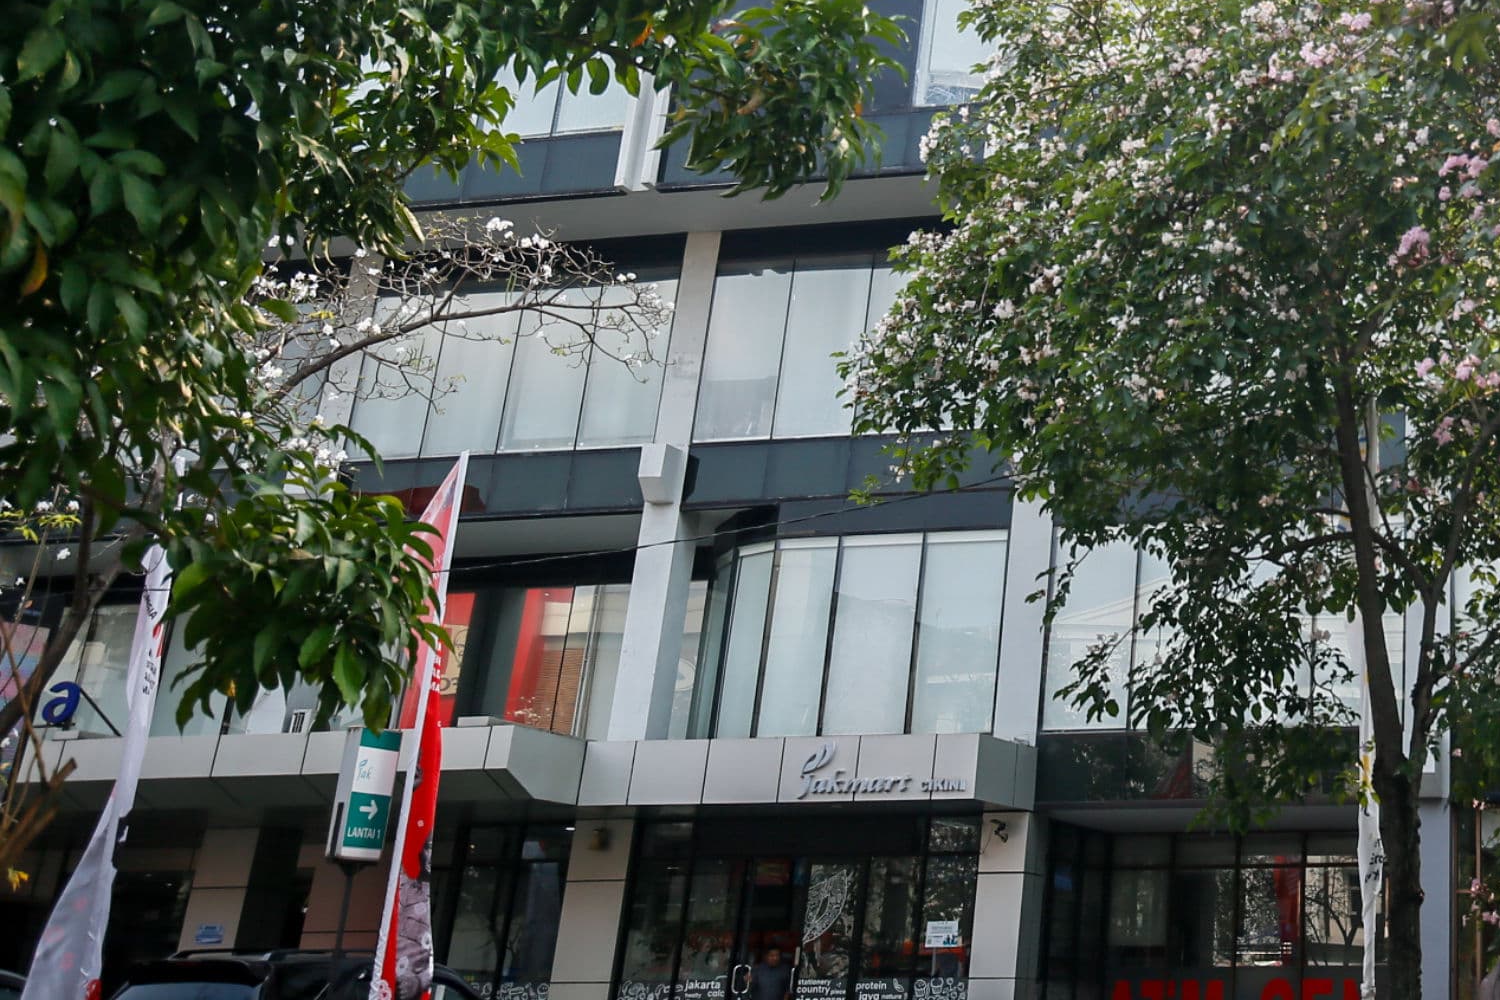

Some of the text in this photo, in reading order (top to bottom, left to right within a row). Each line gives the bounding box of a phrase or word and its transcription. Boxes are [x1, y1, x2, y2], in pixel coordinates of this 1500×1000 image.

[920, 778, 968, 792] CIKINI
[347, 827, 376, 839] LANTAI
[684, 979, 721, 992] jakarta
[796, 984, 831, 995] country
[855, 980, 887, 993] protein
